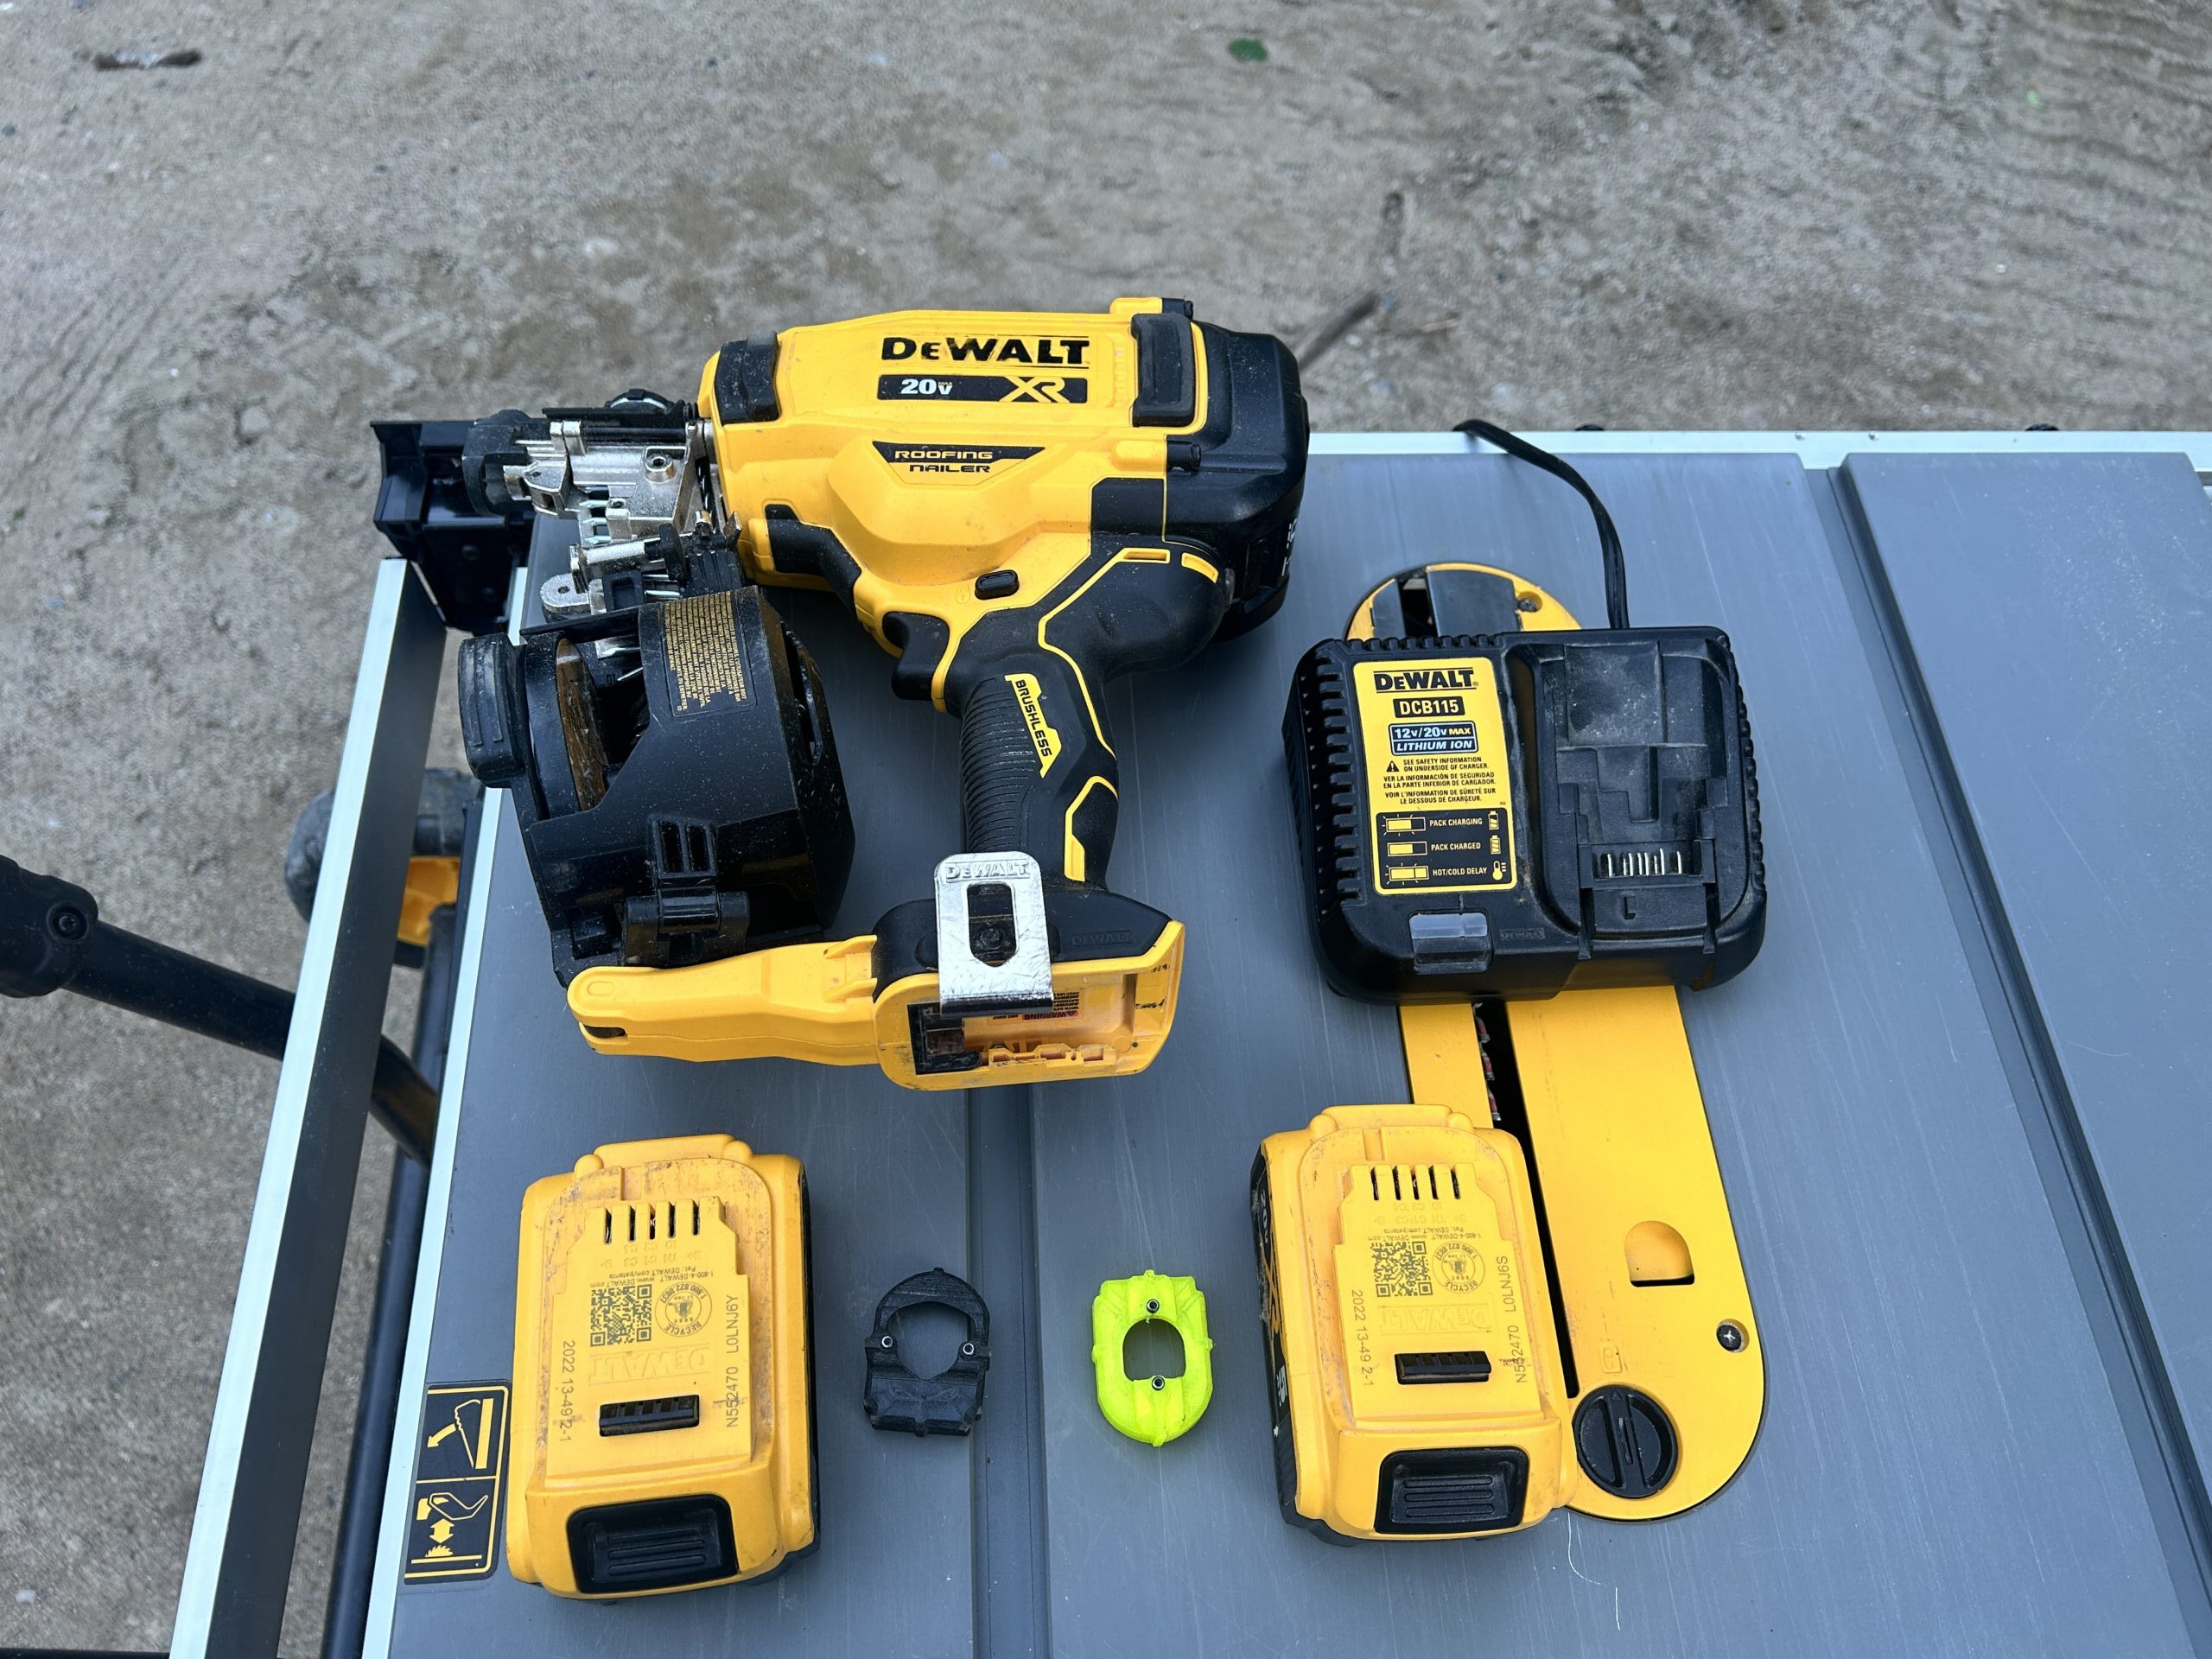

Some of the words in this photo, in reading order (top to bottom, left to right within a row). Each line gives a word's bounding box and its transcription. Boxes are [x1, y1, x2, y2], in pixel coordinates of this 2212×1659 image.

[881, 338, 1090, 364] DEWALT
[999, 376, 1071, 403] XR
[894, 450, 993, 459] ROOFING
[1374, 671, 1473, 690] DEWALT
[1399, 700, 1459, 715] DCB115
[1015, 679, 1052, 757] BRUSHLESS
[1397, 741, 1446, 751] LITHIUM
[1448, 817, 1483, 826] CHARGING
[945, 863, 1029, 880] DEWALT
[1433, 868, 1465, 876] HOT/COLD
[1445, 1279, 1478, 1293] RECYCLE
[1351, 1289, 1366, 1320] 2022
[665, 1321, 702, 1336] RECYCLE
[1357, 1325, 1371, 1362] 13-49
[563, 1340, 575, 1373] 2022
[561, 1378, 574, 1416] 13-49
